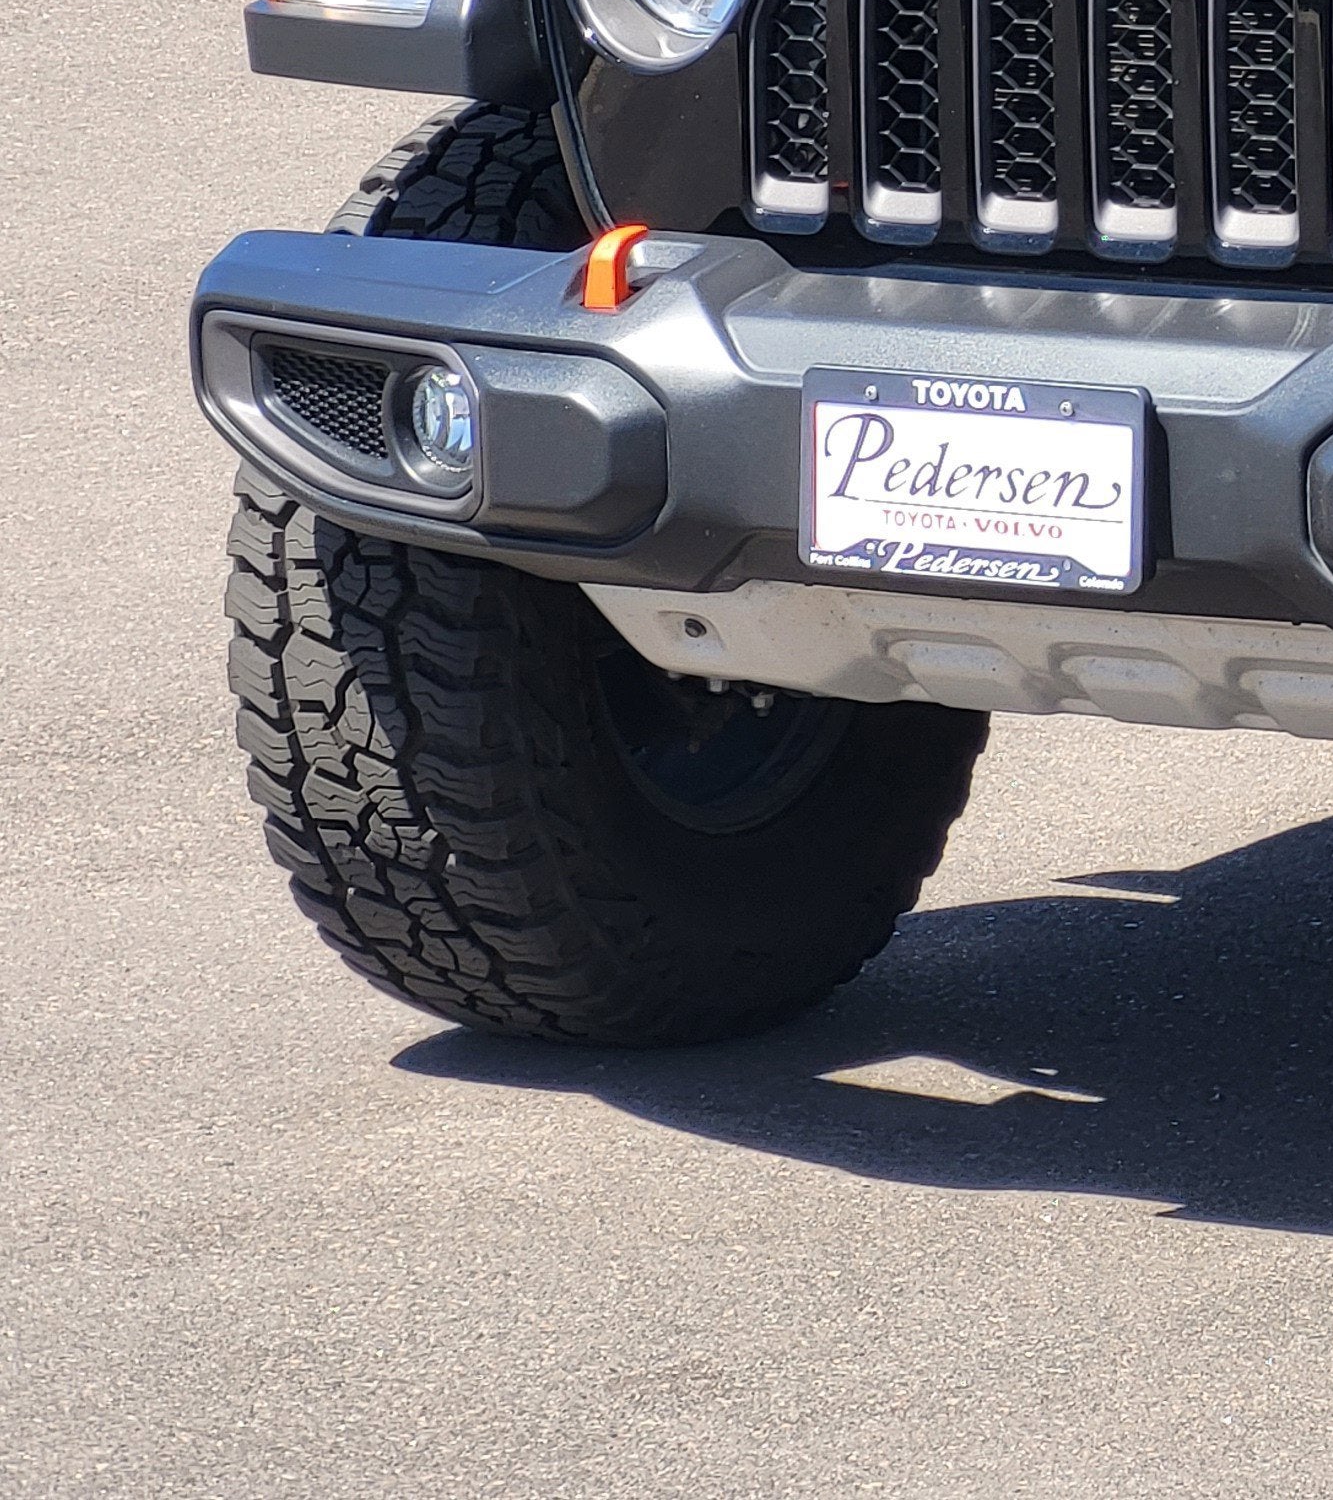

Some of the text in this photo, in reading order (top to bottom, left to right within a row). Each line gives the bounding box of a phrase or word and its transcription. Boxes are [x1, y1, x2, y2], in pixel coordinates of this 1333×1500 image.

[912, 379, 1026, 413] TOYOTA
[824, 412, 1122, 509] Pedersen
[883, 509, 1062, 539] TOYOTA VOLVO
[876, 539, 1060, 583] Pedersen
